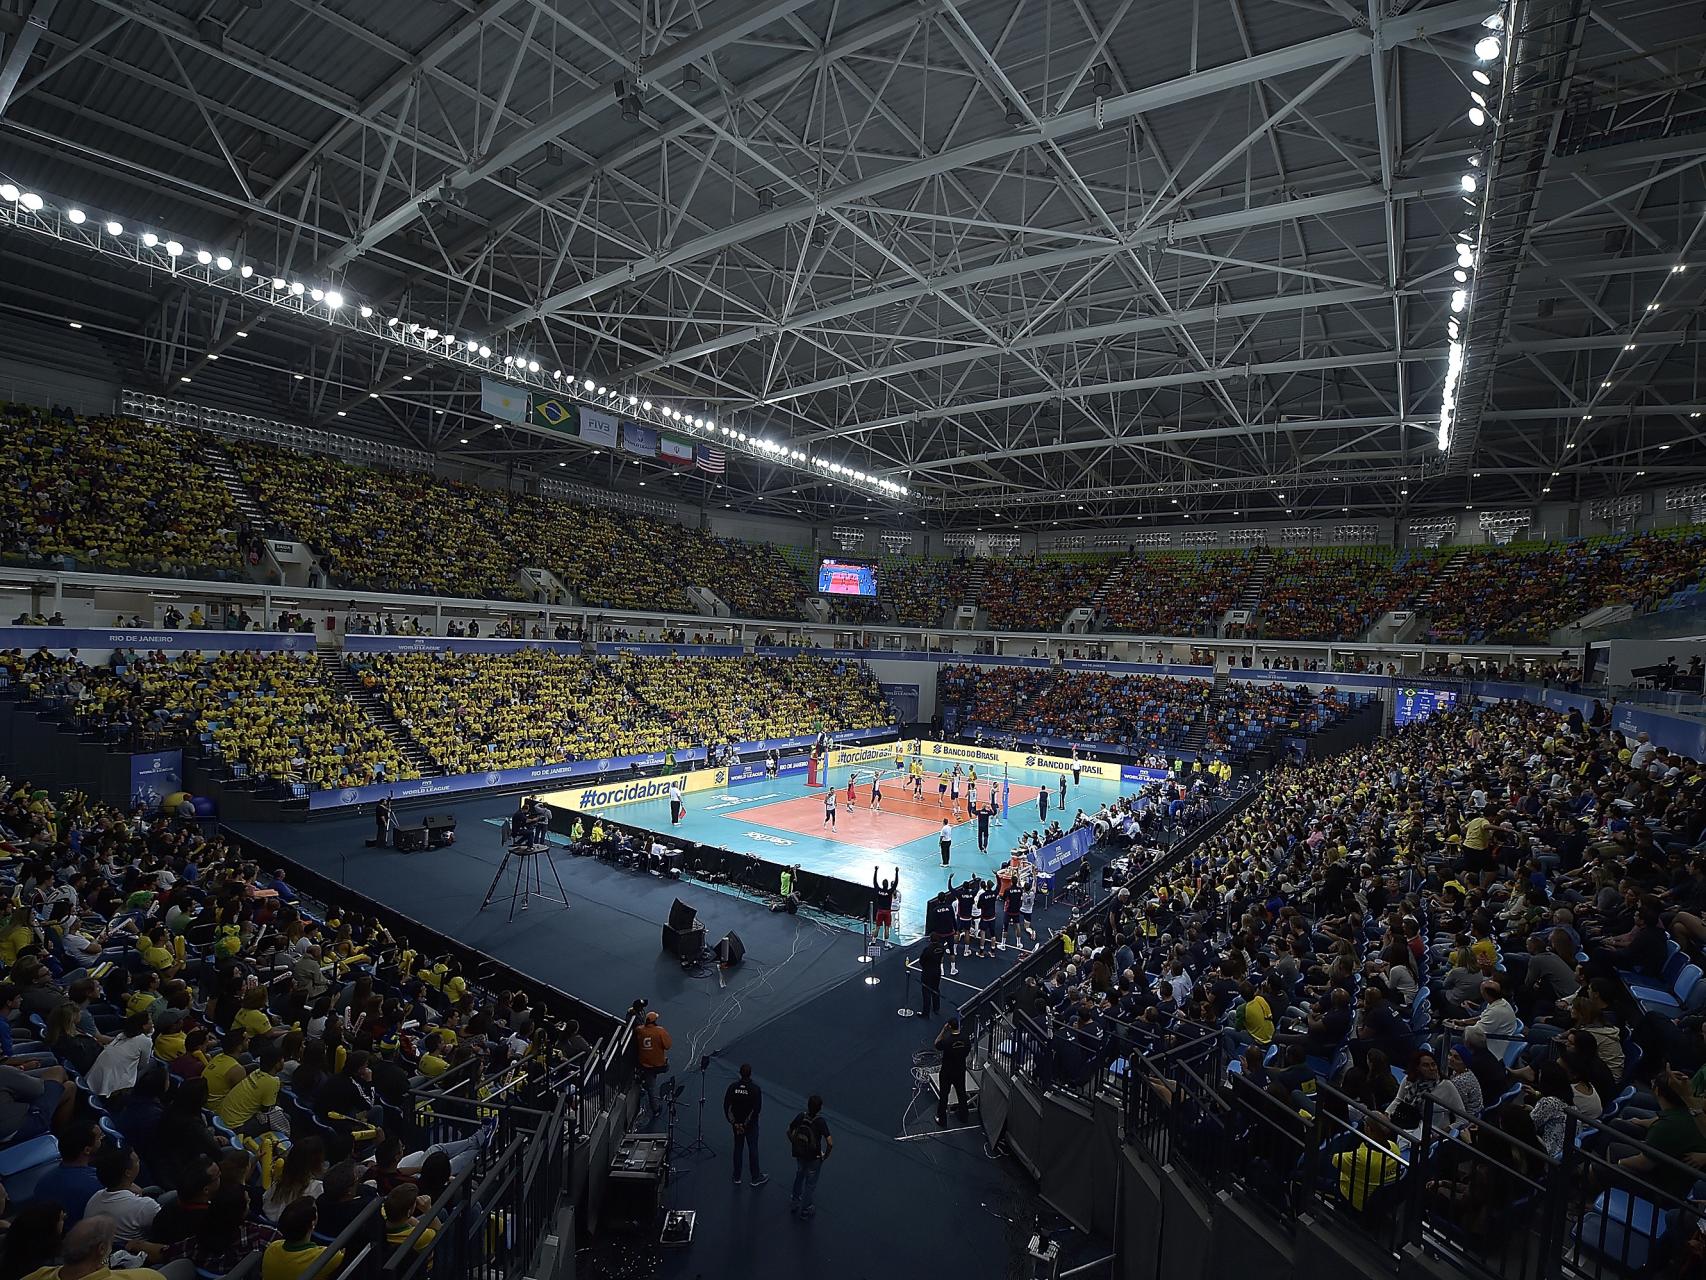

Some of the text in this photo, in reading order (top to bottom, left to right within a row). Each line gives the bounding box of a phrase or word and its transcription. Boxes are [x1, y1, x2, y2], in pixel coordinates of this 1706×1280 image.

[943, 746, 966, 757] BANCO
[976, 750, 999, 761] BRASIL
[1037, 758, 1063, 769] BANCO
[1079, 764, 1103, 775] RASIL
[402, 785, 450, 796] WORLD LEAGUE
